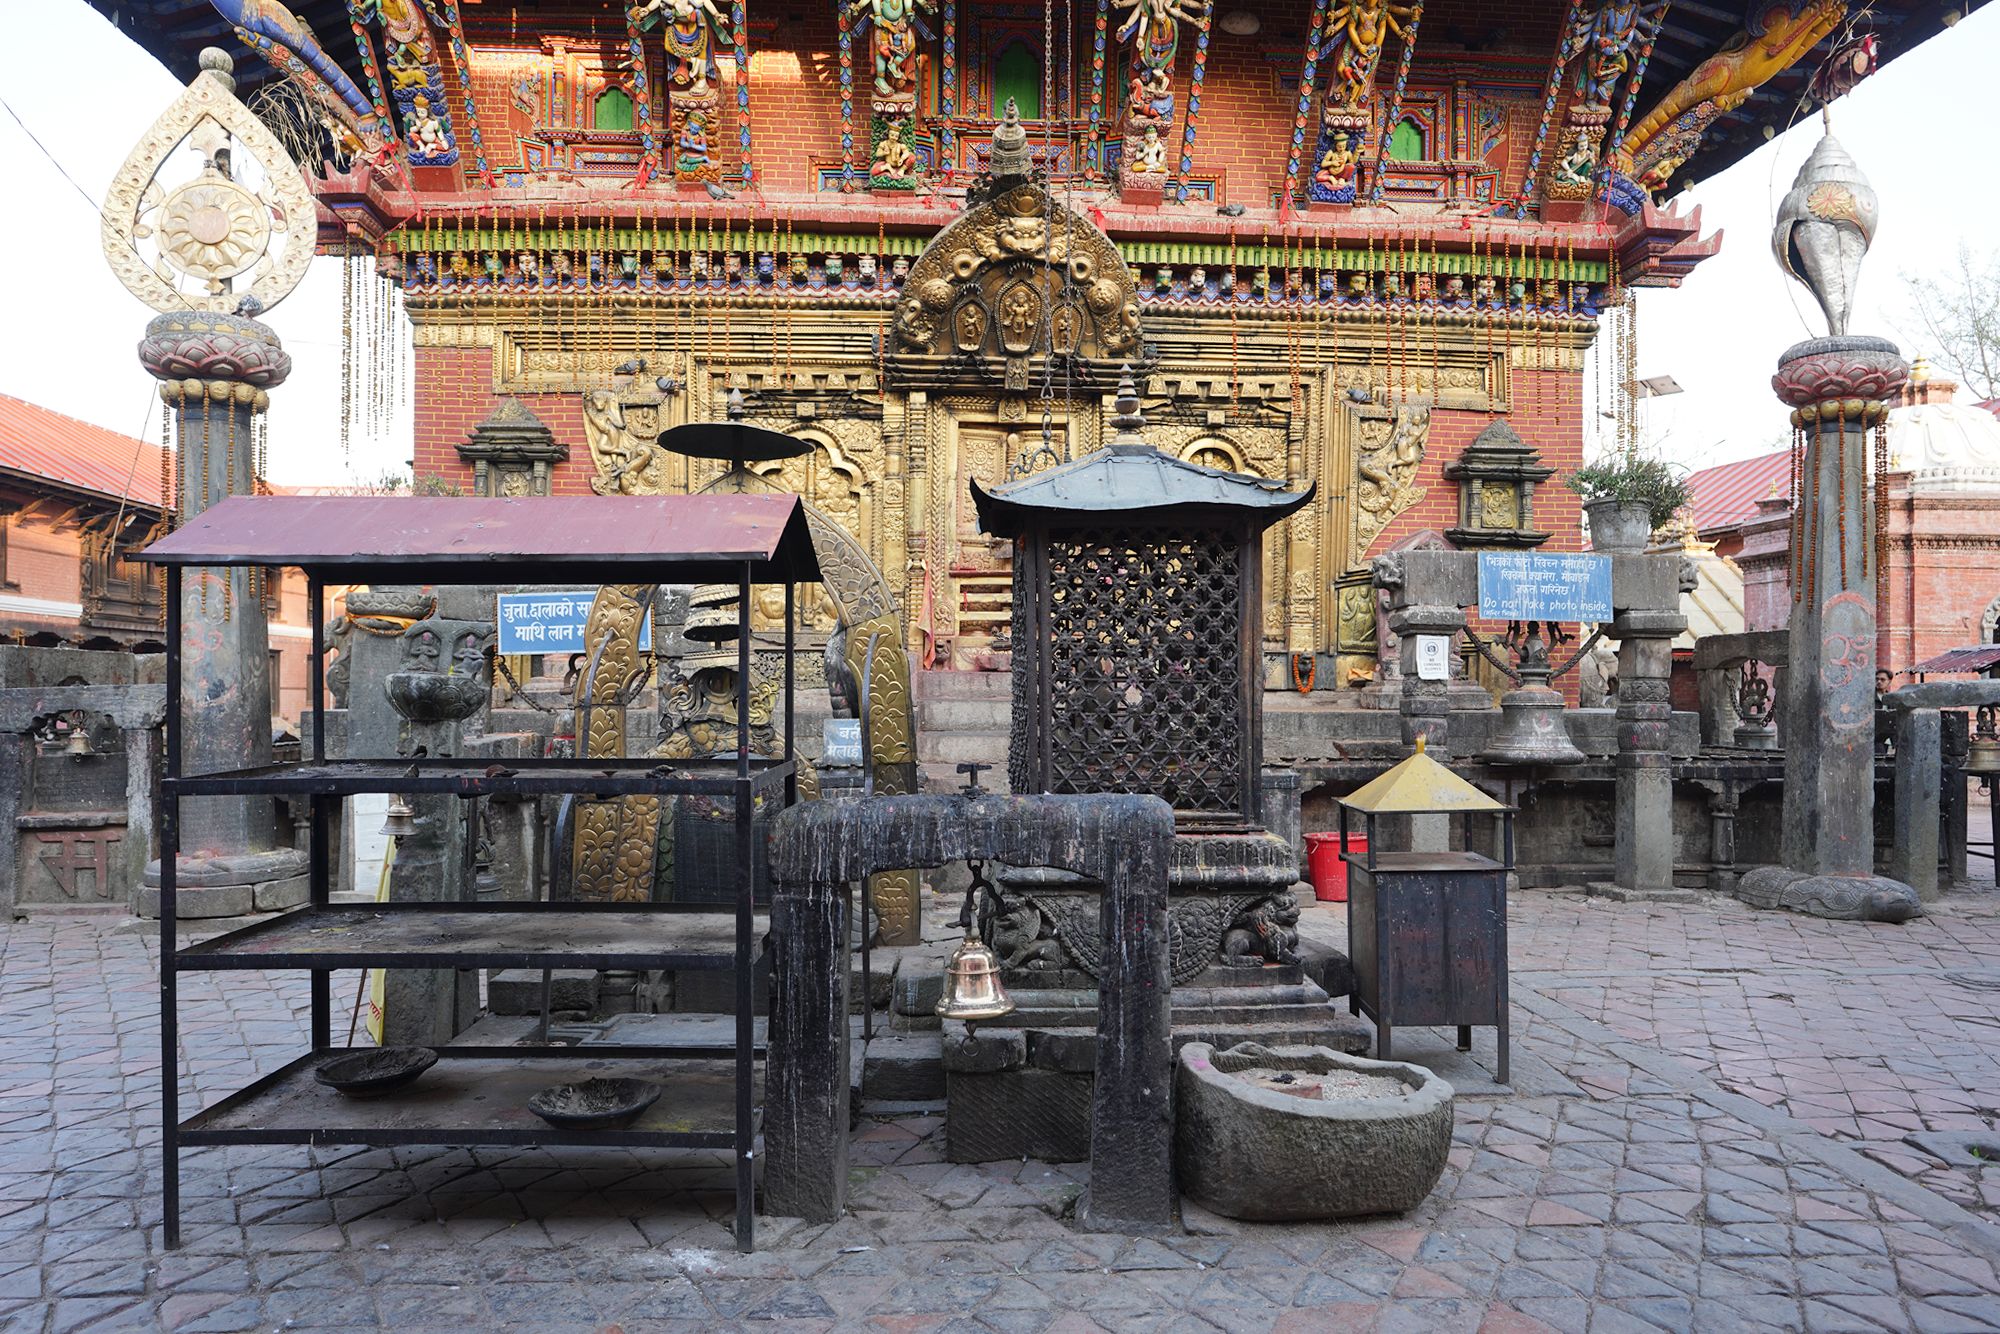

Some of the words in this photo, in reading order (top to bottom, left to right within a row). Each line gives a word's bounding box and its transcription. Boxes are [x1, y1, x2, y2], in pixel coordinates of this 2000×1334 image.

[1483, 597, 1497, 609] Do
[1549, 598, 1577, 616] photo
[514, 621, 546, 642] माथि
[548, 624, 574, 642] लान
